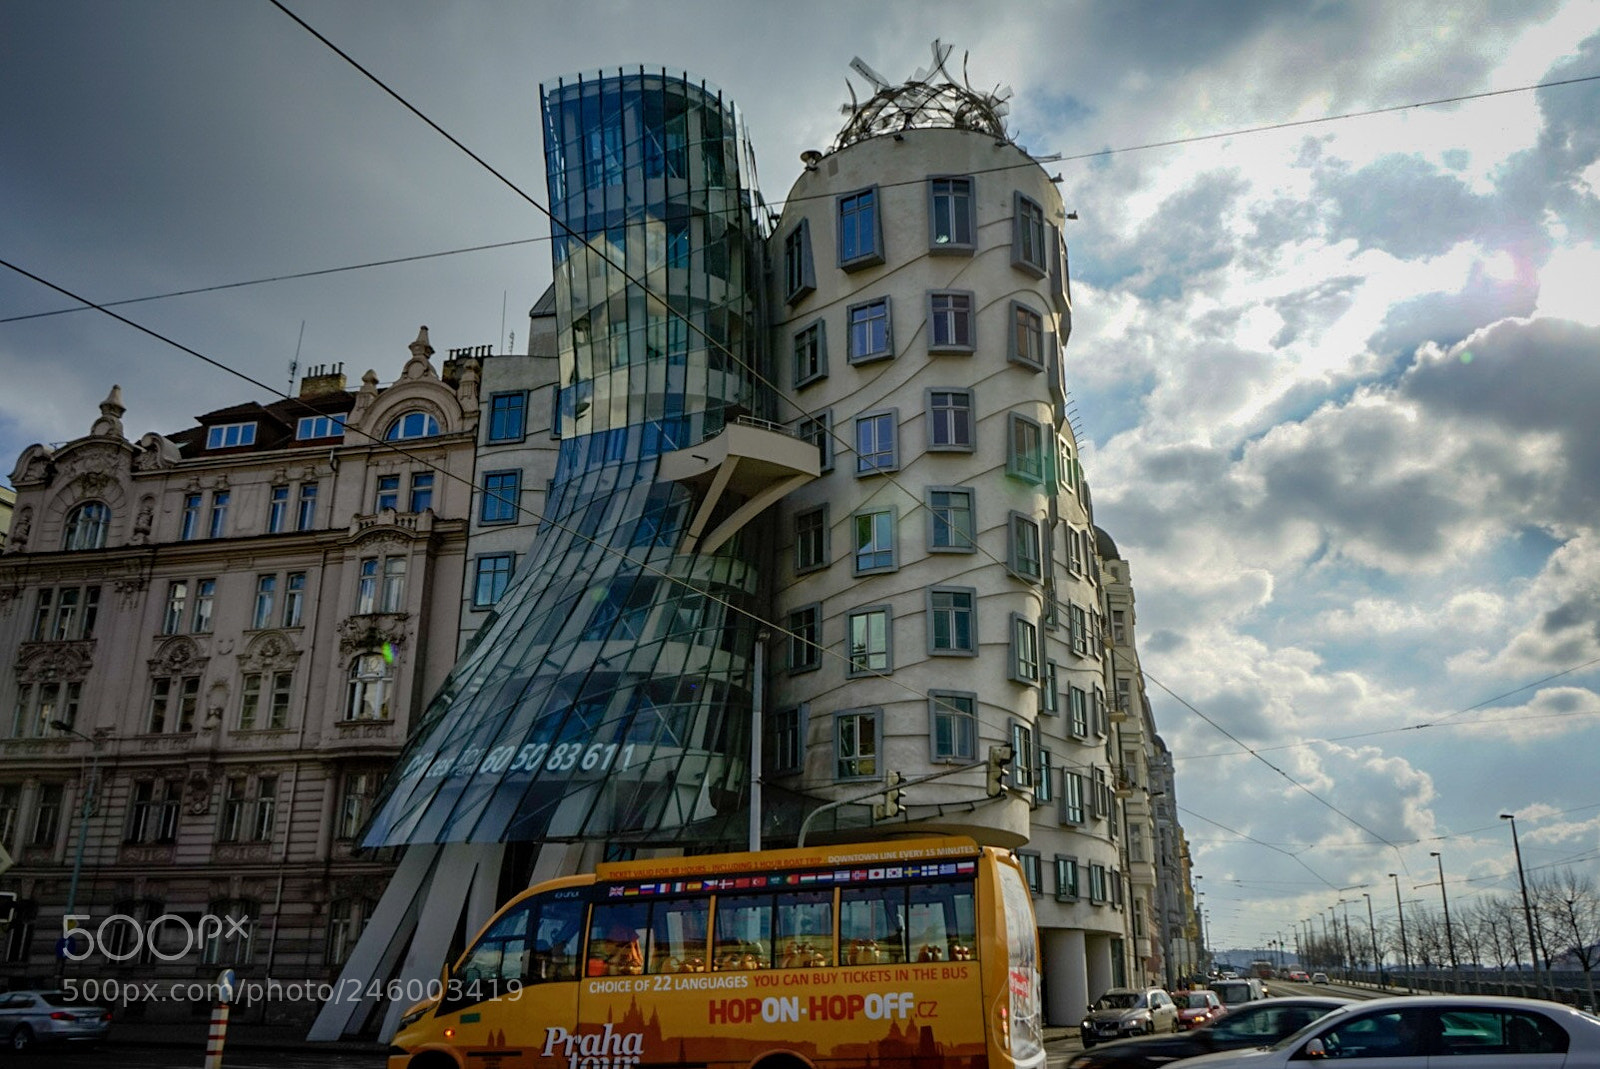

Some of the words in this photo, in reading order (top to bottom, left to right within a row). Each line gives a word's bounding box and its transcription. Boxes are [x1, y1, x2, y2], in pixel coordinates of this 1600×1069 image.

[828, 853, 879, 863] DOWNTOWN
[880, 852, 897, 860] LINE
[899, 850, 923, 859] EVERY
[926, 849, 935, 857] 15
[937, 845, 974, 855] MINUTES
[609, 870, 631, 878] TICKET
[633, 869, 654, 877] VALID
[655, 868, 669, 876] FOR
[681, 865, 705, 874] HOURS
[712, 861, 751, 872] INCLUDING
[761, 859, 782, 868] HOUR
[806, 856, 822, 865] TRIP
[589, 980, 632, 994] CHOICE
[634, 979, 650, 992] OF
[653, 975, 672, 991] 22
[675, 975, 748, 990] LANGUAGES
[753, 974, 779, 987] YOU
[783, 973, 809, 986] CAN
[813, 972, 839, 984] BUY
[841, 970, 892, 983] TICKETS
[895, 969, 909, 981] IN
[912, 968, 937, 980] THE
[942, 967, 968, 979] BUS
[541, 1023, 645, 1057] Praha
